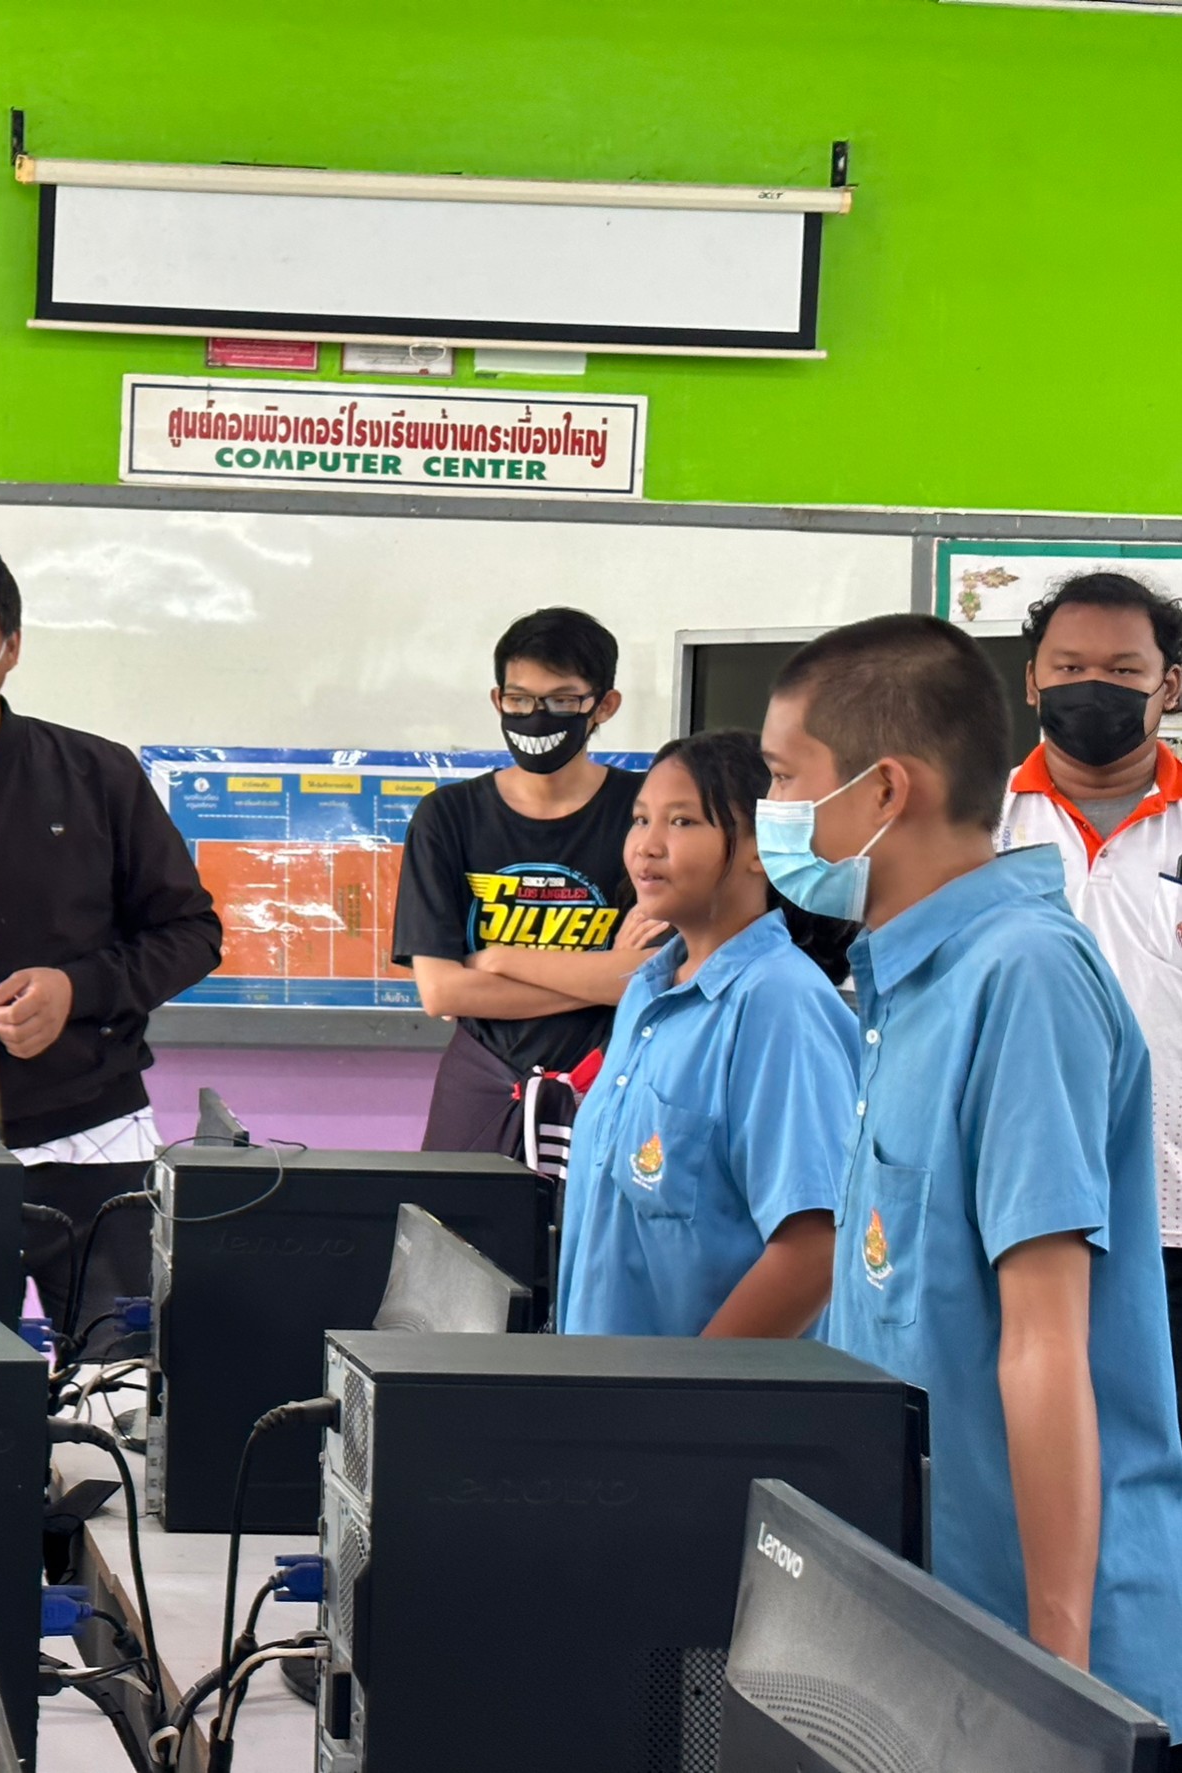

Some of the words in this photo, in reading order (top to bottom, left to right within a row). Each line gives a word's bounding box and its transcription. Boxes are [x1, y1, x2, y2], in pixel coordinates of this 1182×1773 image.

[215, 447, 402, 475] COMPUTER
[423, 456, 547, 481] CENTER
[465, 873, 619, 945] SILVER
[518, 886, 538, 899] LOS
[540, 887, 588, 900] ANGELES
[757, 1521, 804, 1579] Lenovo
